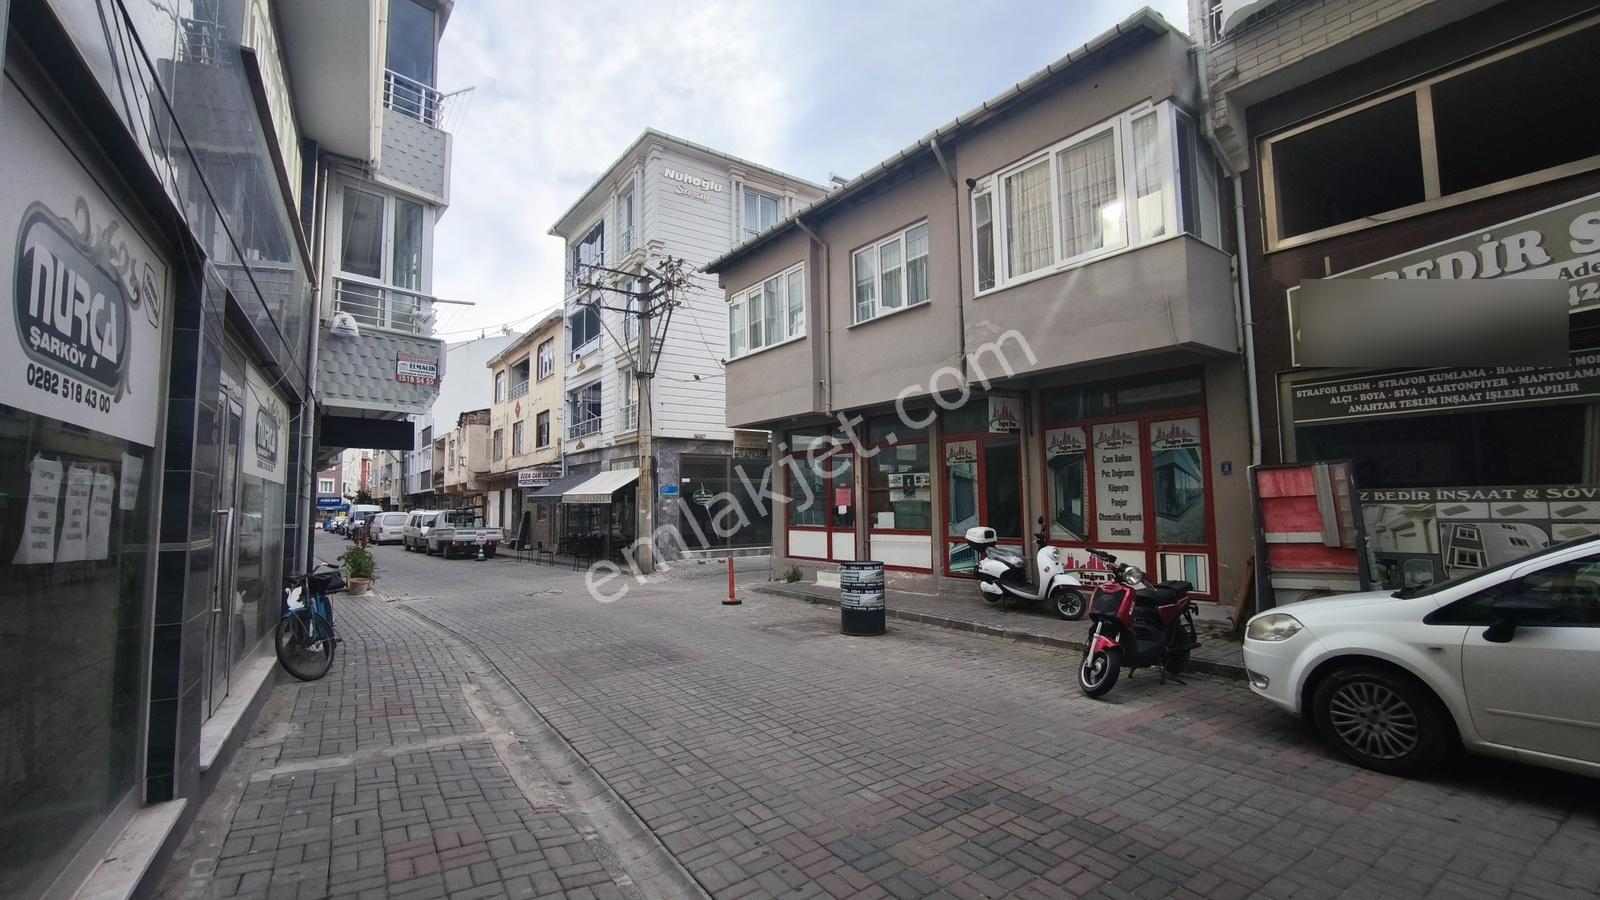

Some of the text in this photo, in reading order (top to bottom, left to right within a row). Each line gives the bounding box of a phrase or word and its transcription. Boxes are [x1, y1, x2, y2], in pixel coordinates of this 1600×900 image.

[663, 167, 722, 191] Nuhoğlu
[29, 325, 87, 368] ŞARKÖY
[27, 363, 110, 413] 0282 518 43 00
[1296, 386, 1338, 398] STRAFOR
[1339, 381, 1370, 393] KESİM
[1378, 375, 1427, 388] STRAFOR
[1428, 369, 1486, 383] KUMLAMA
[1330, 395, 1353, 404] ALÇI
[1360, 391, 1386, 400] BOYA
[1394, 388, 1419, 397] SIVA
[1348, 401, 1396, 413] ANAHTAR
[1528, 383, 1579, 396] YAPILIR
[1111, 469, 1135, 479] Doğrama
[1374, 489, 1431, 500] BEDİR
[1436, 488, 1517, 501] İNŞAAT
[1523, 489, 1540, 499] &
[1099, 513, 1121, 521] Otomatik
